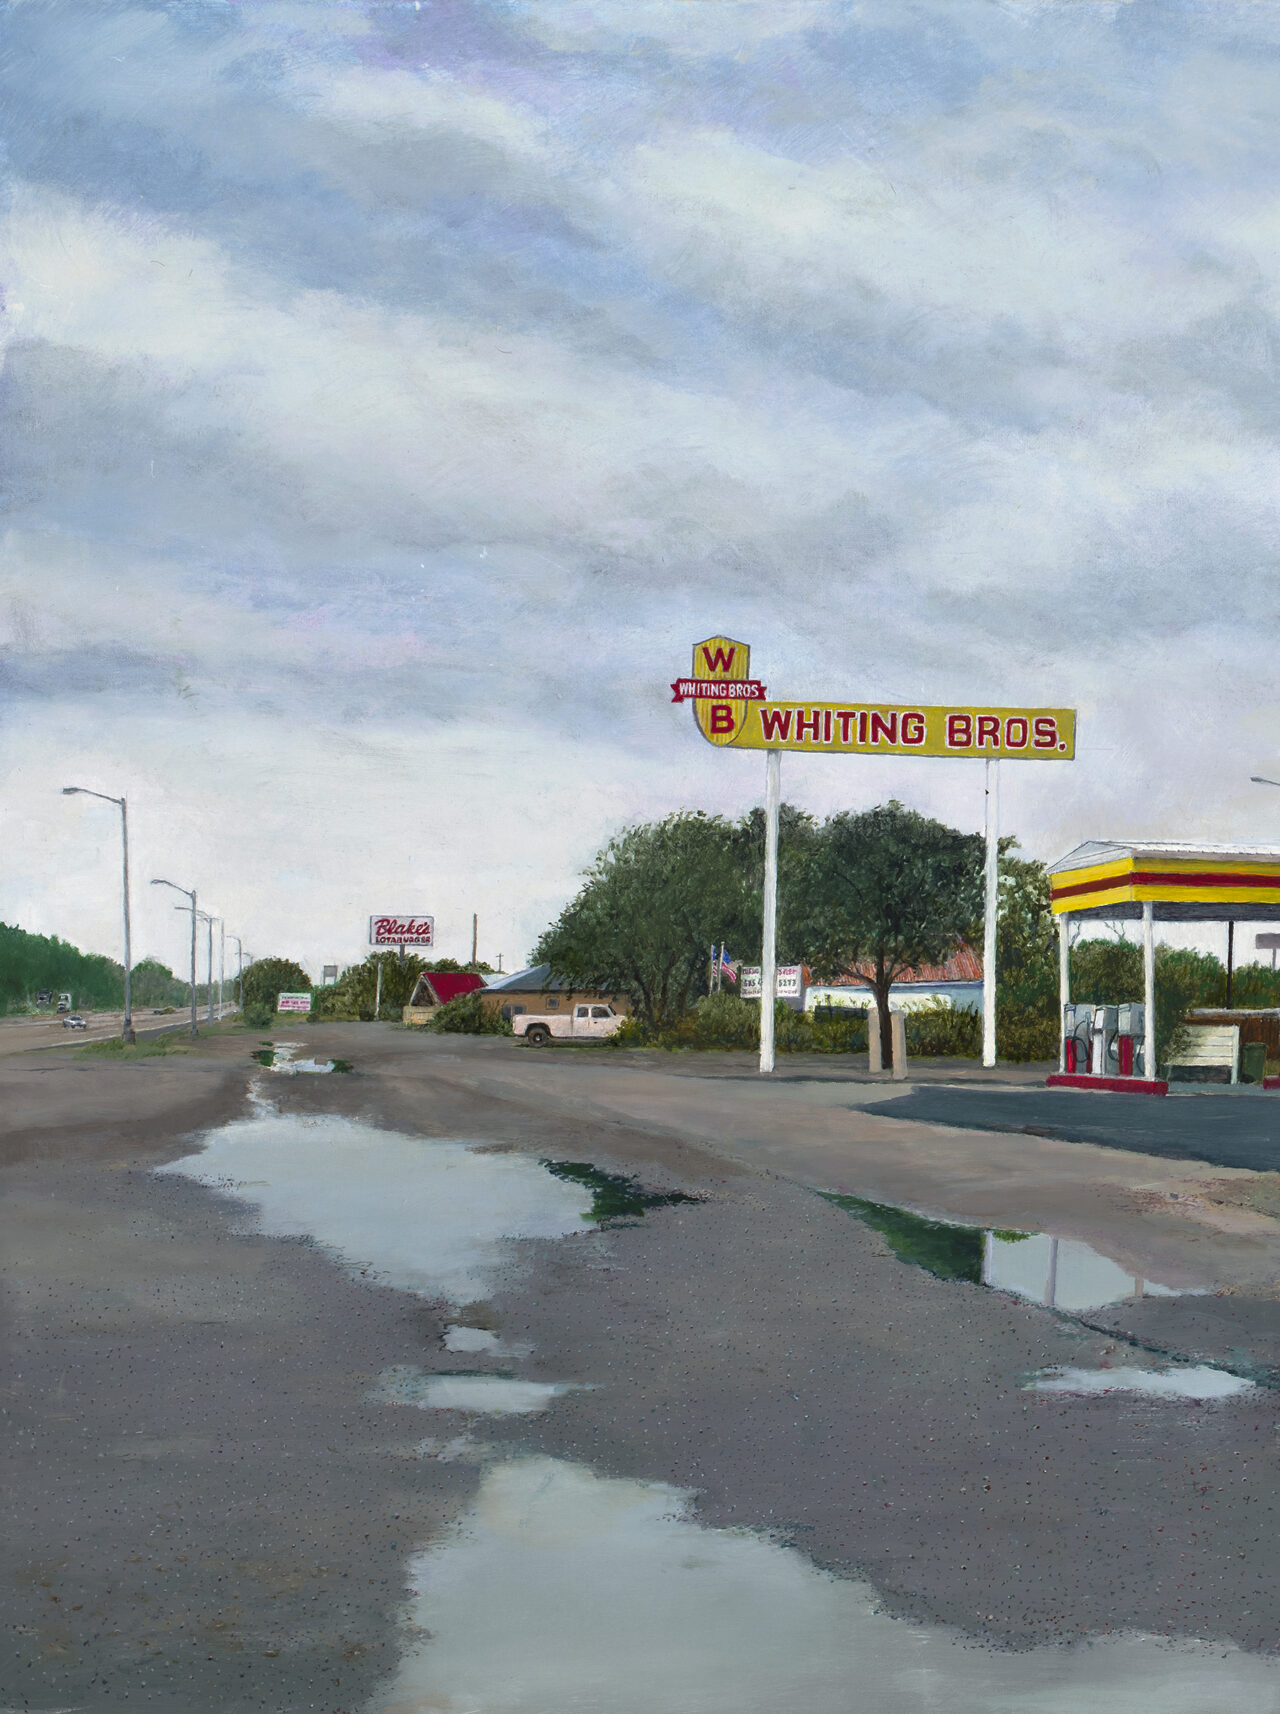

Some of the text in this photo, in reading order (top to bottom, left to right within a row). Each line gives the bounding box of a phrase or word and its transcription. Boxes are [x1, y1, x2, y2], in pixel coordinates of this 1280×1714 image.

[702, 647, 736, 672] W
[679, 682, 759, 698] WHITING BROS
[711, 705, 735, 734] B
[759, 707, 1067, 752] WHITING BROS.
[374, 918, 430, 936] Blake's
